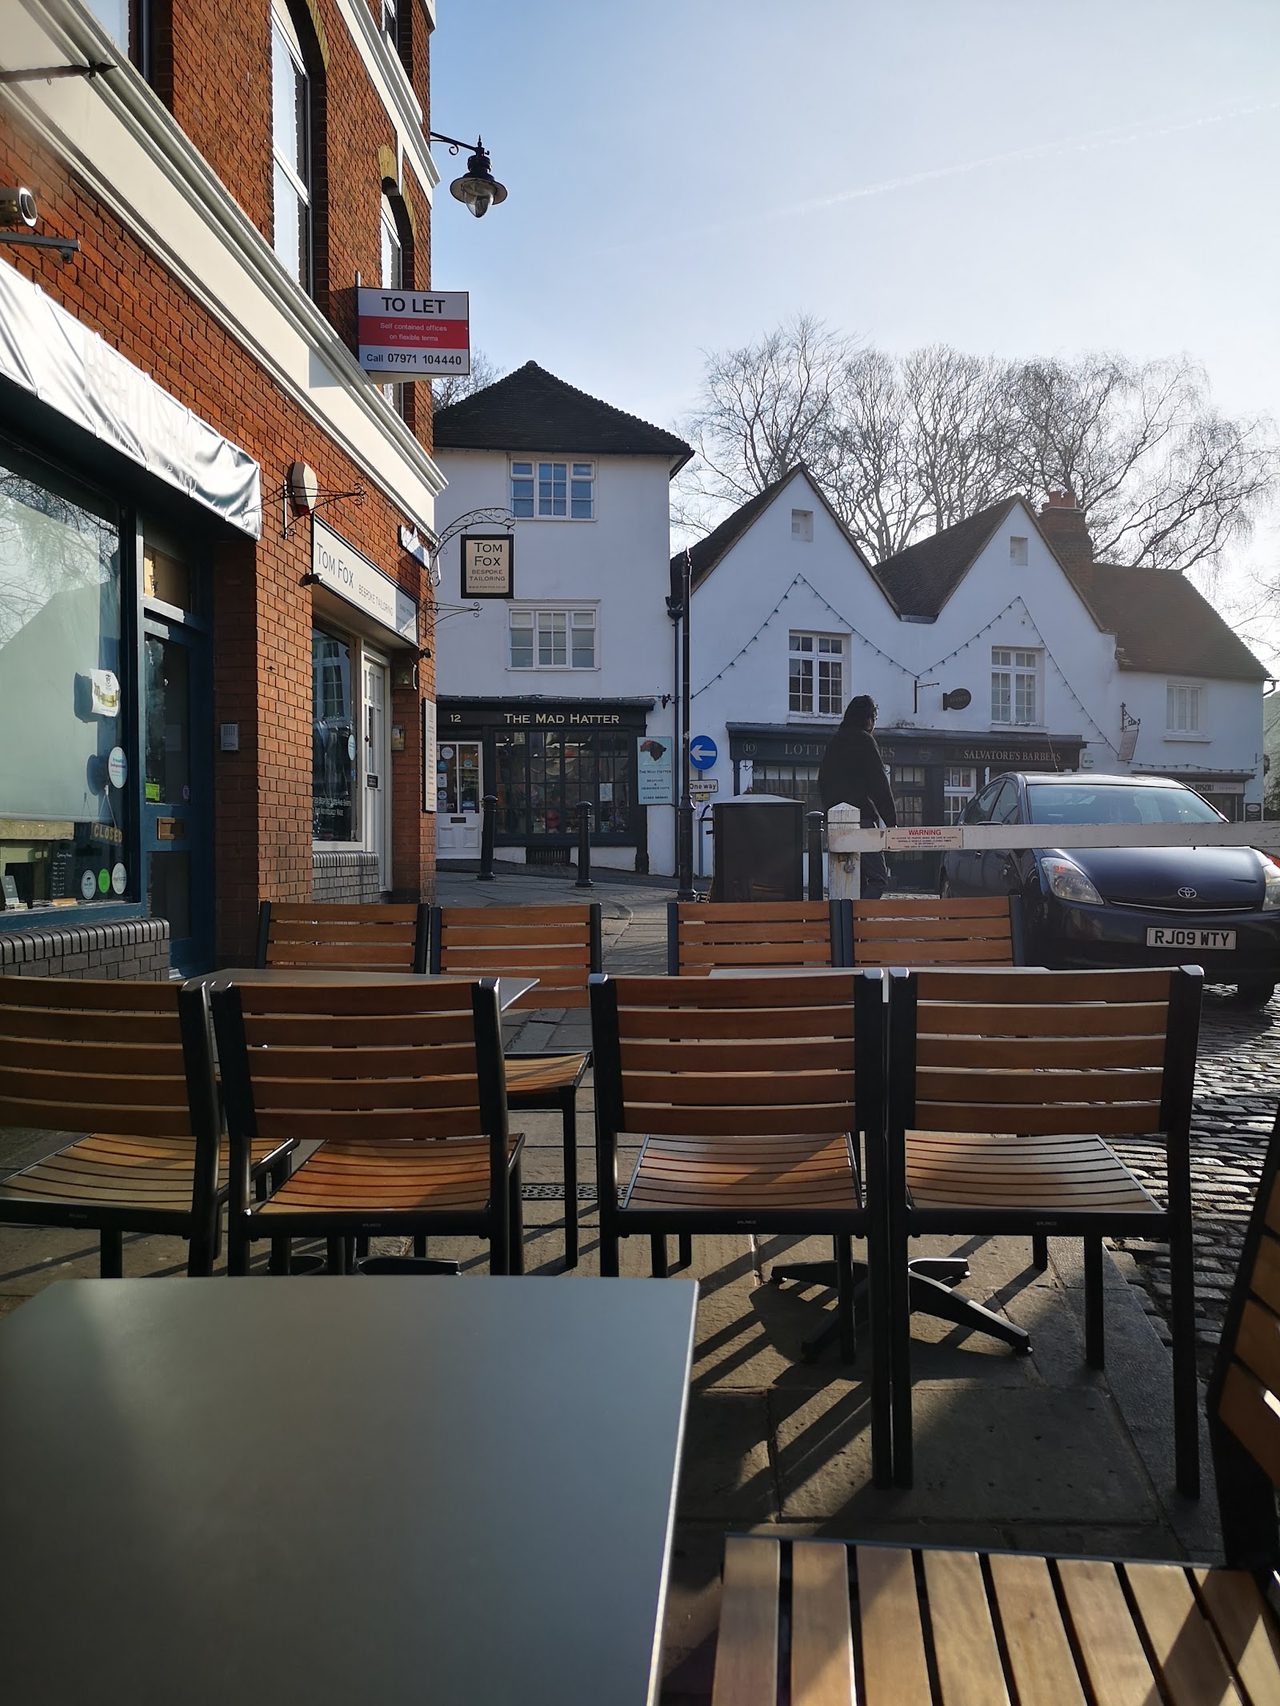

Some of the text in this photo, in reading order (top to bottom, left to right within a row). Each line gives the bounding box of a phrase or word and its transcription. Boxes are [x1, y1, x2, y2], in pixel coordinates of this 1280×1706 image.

[381, 297, 446, 314] TO LET
[380, 322, 448, 332] Self contained offices
[366, 353, 462, 365] Call 07971 104440
[474, 542, 503, 553] TOM
[316, 542, 336, 576] TOM
[338, 559, 354, 589] FOX
[474, 555, 501, 567] FOX
[450, 714, 462, 723] 12
[503, 713, 620, 724] THE MAD HATTER
[963, 750, 1062, 762] SALVATORE'S BARBERS
[689, 782, 703, 790] One
[93, 823, 123, 843] CLOSED
[1154, 930, 1230, 947] RJ09 WTY
